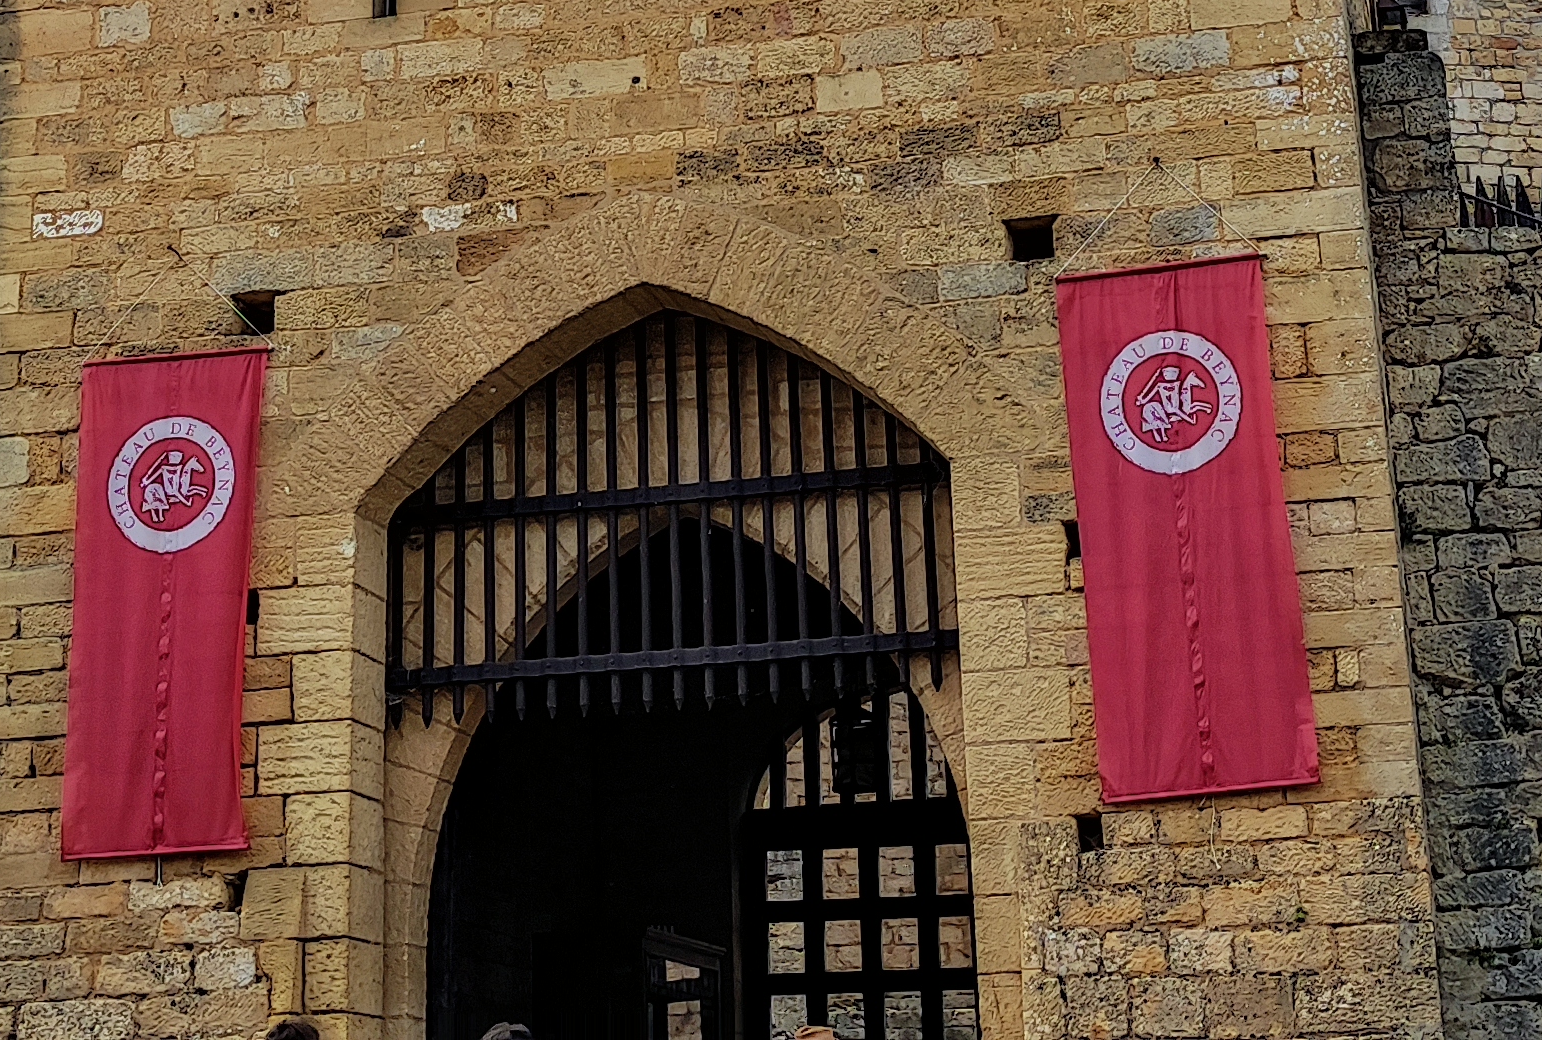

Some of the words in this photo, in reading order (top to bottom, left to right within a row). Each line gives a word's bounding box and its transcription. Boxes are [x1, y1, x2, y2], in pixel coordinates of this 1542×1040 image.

[1105, 343, 1147, 452] CHATEAU
[1160, 336, 1190, 352] DE
[1199, 347, 1237, 443] BEYNAC
[113, 427, 156, 530] CHATEAU
[170, 421, 197, 437] DE
[201, 435, 231, 526] BEYNAC
